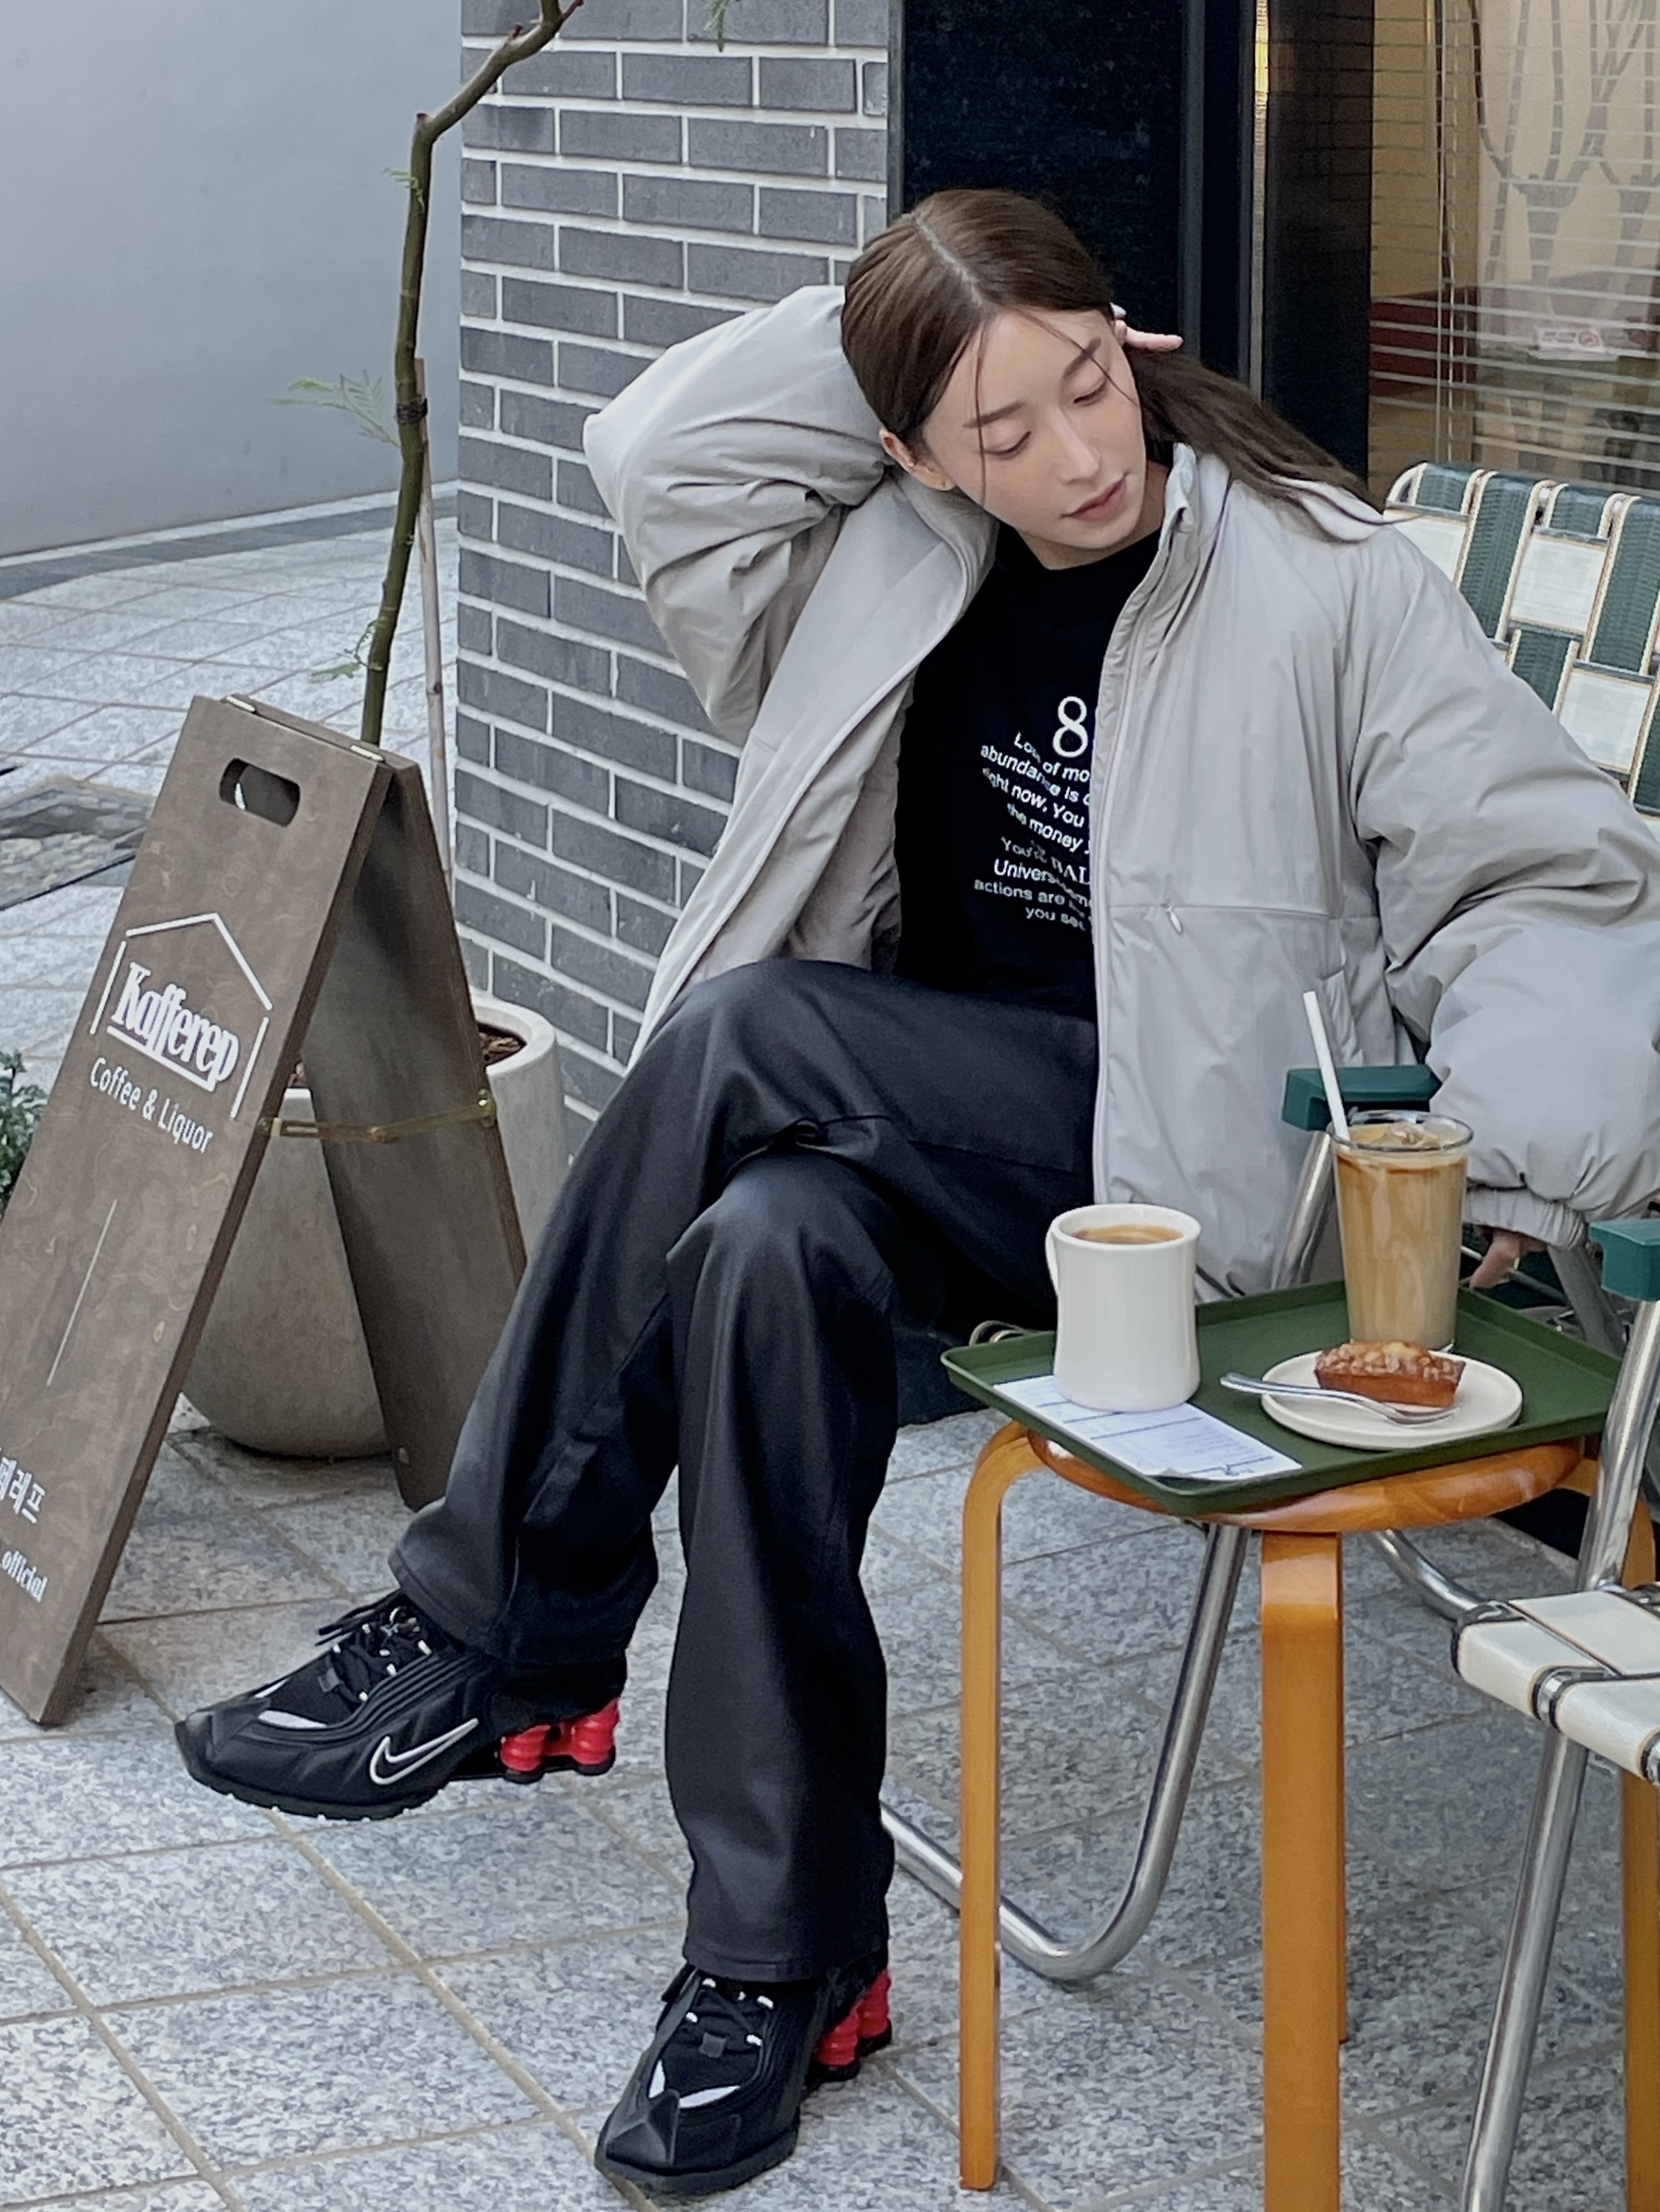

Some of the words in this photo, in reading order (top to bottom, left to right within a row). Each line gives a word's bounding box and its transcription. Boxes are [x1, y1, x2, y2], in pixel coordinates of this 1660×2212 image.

[1053, 696, 1088, 758] 8
[1042, 761, 1061, 776] of
[1053, 803, 1085, 828] You
[1029, 818, 1084, 855] money
[994, 858, 1058, 885] Univers
[974, 879, 1032, 901] actions
[1038, 892, 1065, 906] are
[1025, 906, 1055, 921] you
[111, 961, 240, 1092] Kafferep
[90, 1057, 142, 1110] Coffee
[142, 1089, 158, 1121] &
[158, 1097, 214, 1153] Liquor
[0, 1446, 46, 1524] 페레프
[0, 1550, 48, 1602] official
